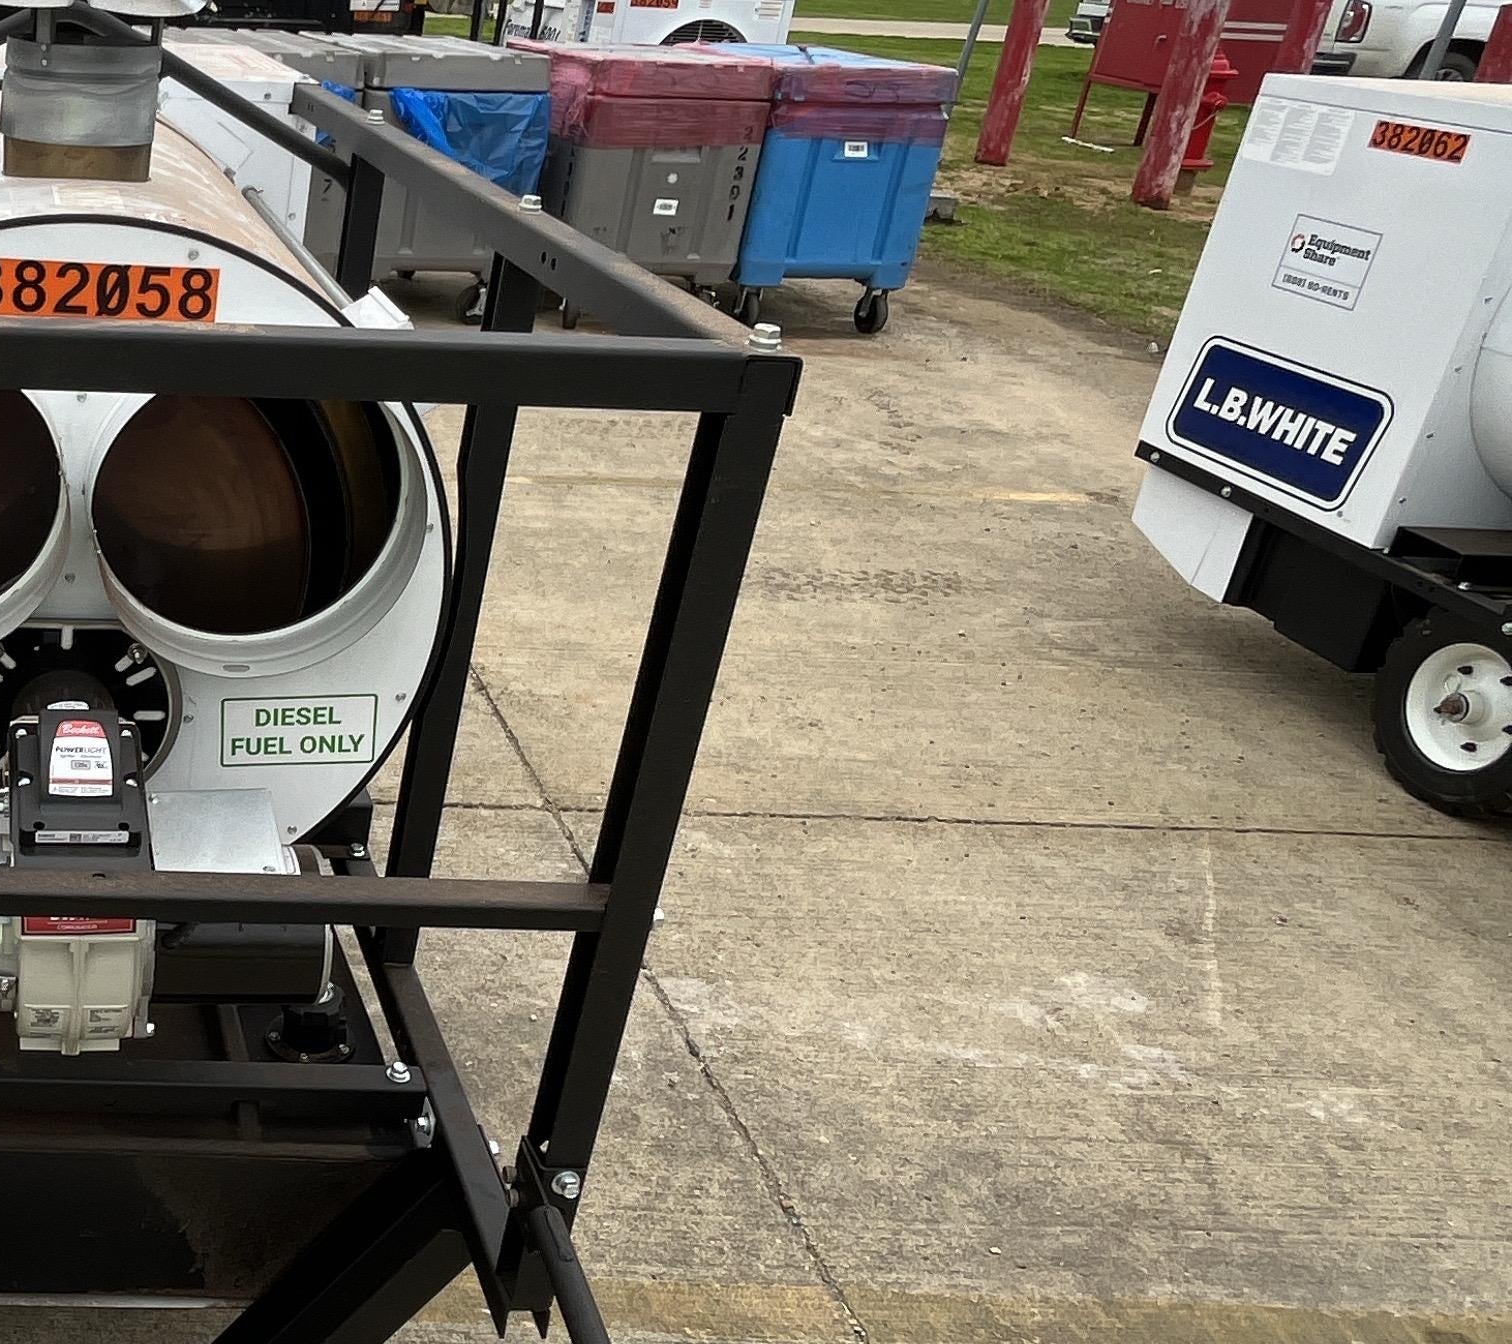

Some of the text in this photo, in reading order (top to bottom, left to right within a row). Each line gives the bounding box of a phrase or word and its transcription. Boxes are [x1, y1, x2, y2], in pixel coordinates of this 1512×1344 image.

[1372, 121, 1470, 161] 382062
[1302, 247, 1337, 267] Share
[1307, 234, 1372, 261] Equipment
[254, 706, 342, 727] DIESEL
[230, 733, 366, 756] FUEL ONLY
